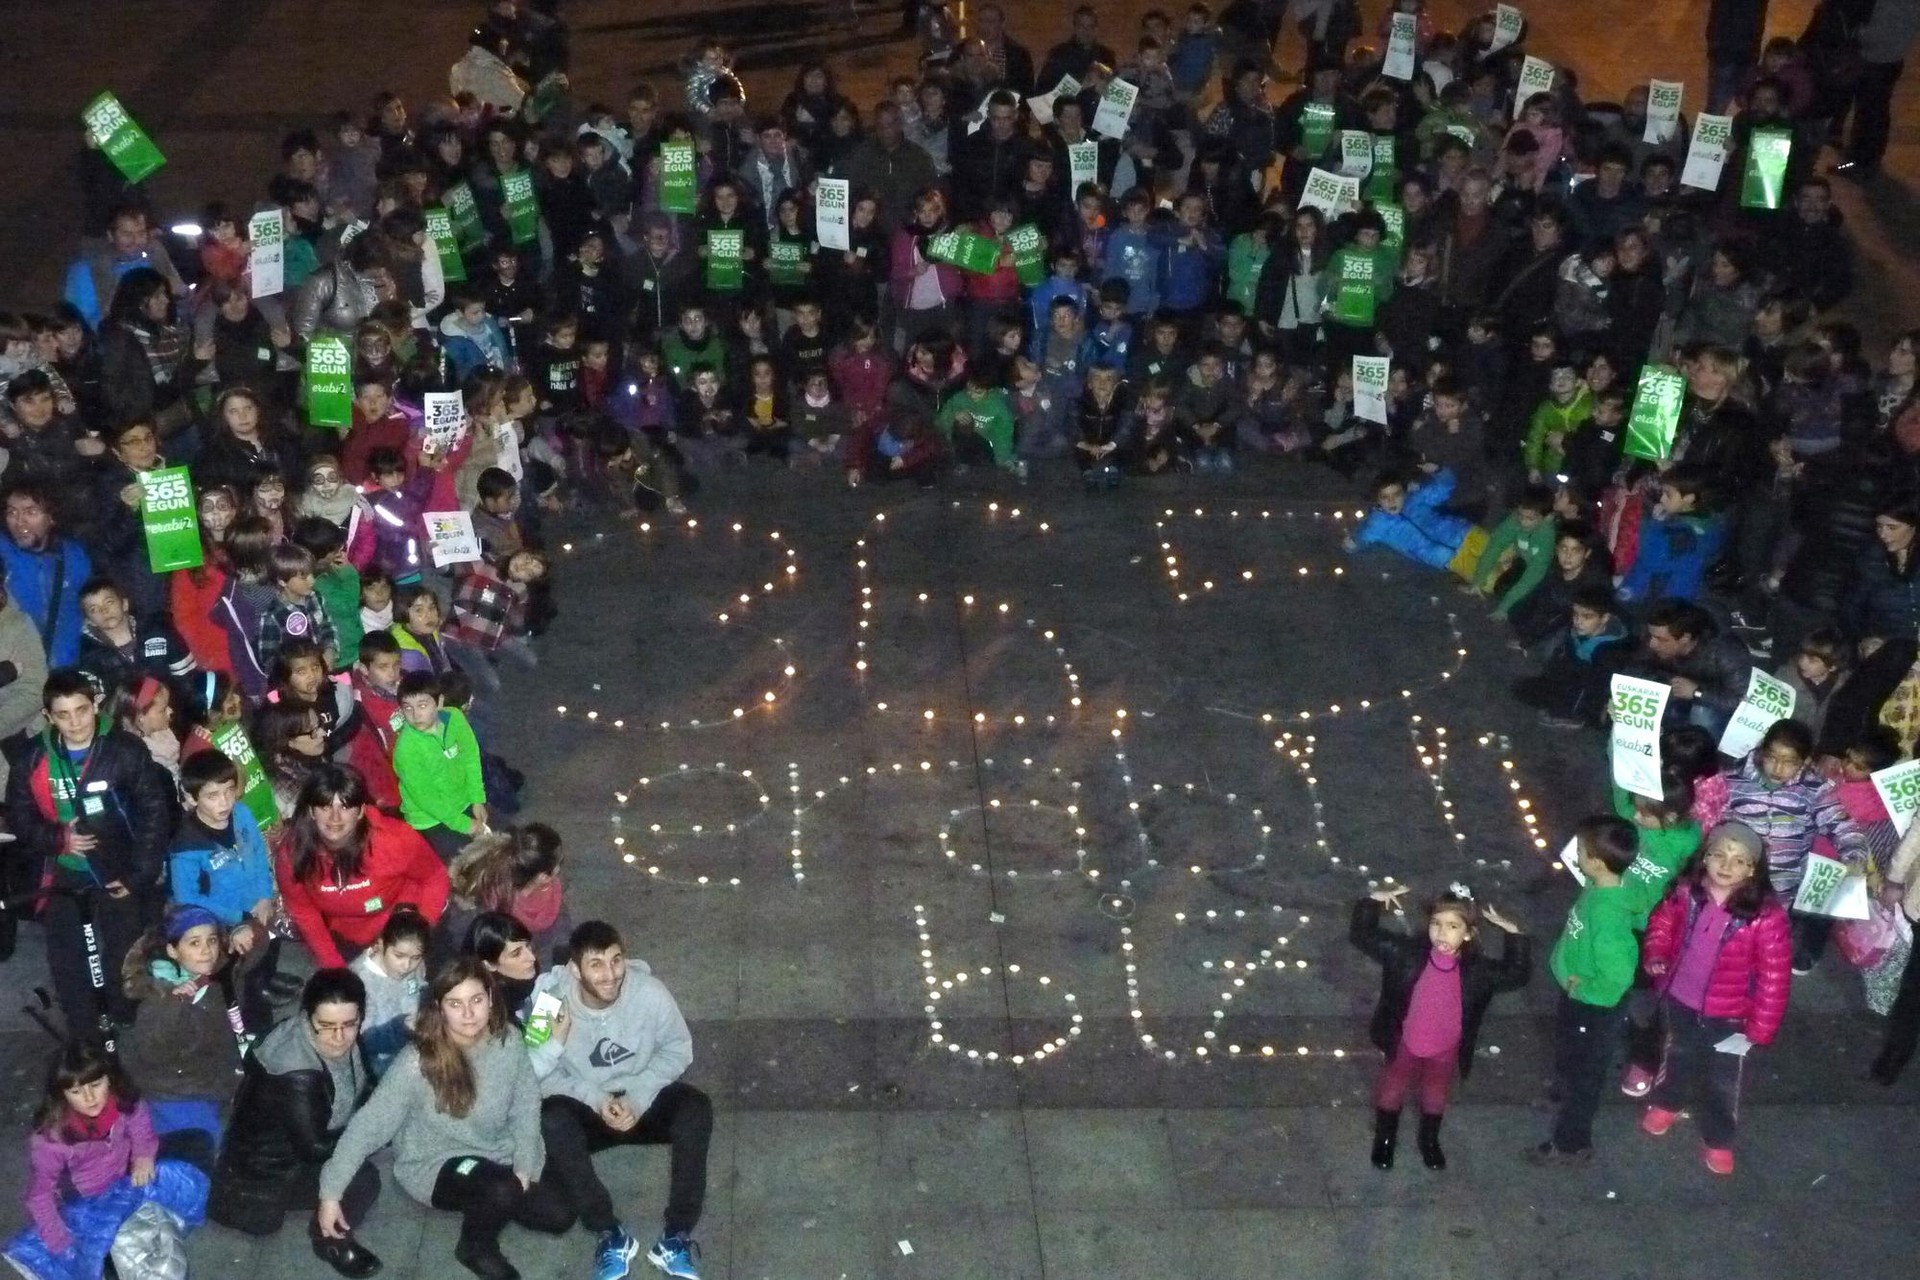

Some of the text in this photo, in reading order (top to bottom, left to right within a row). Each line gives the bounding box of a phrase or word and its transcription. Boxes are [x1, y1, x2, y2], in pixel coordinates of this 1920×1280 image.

[1525, 64, 1550, 80] 365
[1652, 88, 1679, 101] 365
[86, 103, 121, 132] 365
[1699, 123, 1729, 139] 365
[1345, 139, 1369, 150] 365
[664, 151, 692, 164] 365
[1073, 151, 1096, 162] 365
[1345, 150, 1369, 158] EGUN
[664, 163, 692, 172] EGUN
[505, 178, 532, 197] 365
[1310, 177, 1338, 195] 365
[508, 190, 533, 203] EGUN
[820, 188, 846, 201] 365
[1307, 187, 1335, 202] EGUN
[819, 199, 846, 209] EGUN
[253, 221, 281, 239] 365
[426, 217, 450, 233] 365
[255, 236, 281, 248] EGUN
[711, 239, 741, 251] 365
[1344, 261, 1373, 273] 365
[1342, 271, 1373, 281] EGUN
[310, 348, 347, 365] 365
[311, 363, 347, 375] EGUN
[1356, 365, 1386, 380] 365
[1356, 376, 1384, 387] EGUN
[433, 404, 460, 418] 365
[433, 416, 459, 425] EGUN
[145, 479, 188, 501] 365
[147, 497, 190, 513] EGUN
[1754, 679, 1790, 708] 365
[1615, 691, 1660, 718] 365
[1748, 694, 1786, 719] EGUN
[1613, 712, 1654, 731] EGUN
[1893, 796, 1920, 814] EGU
[1803, 863, 1834, 904] 365
